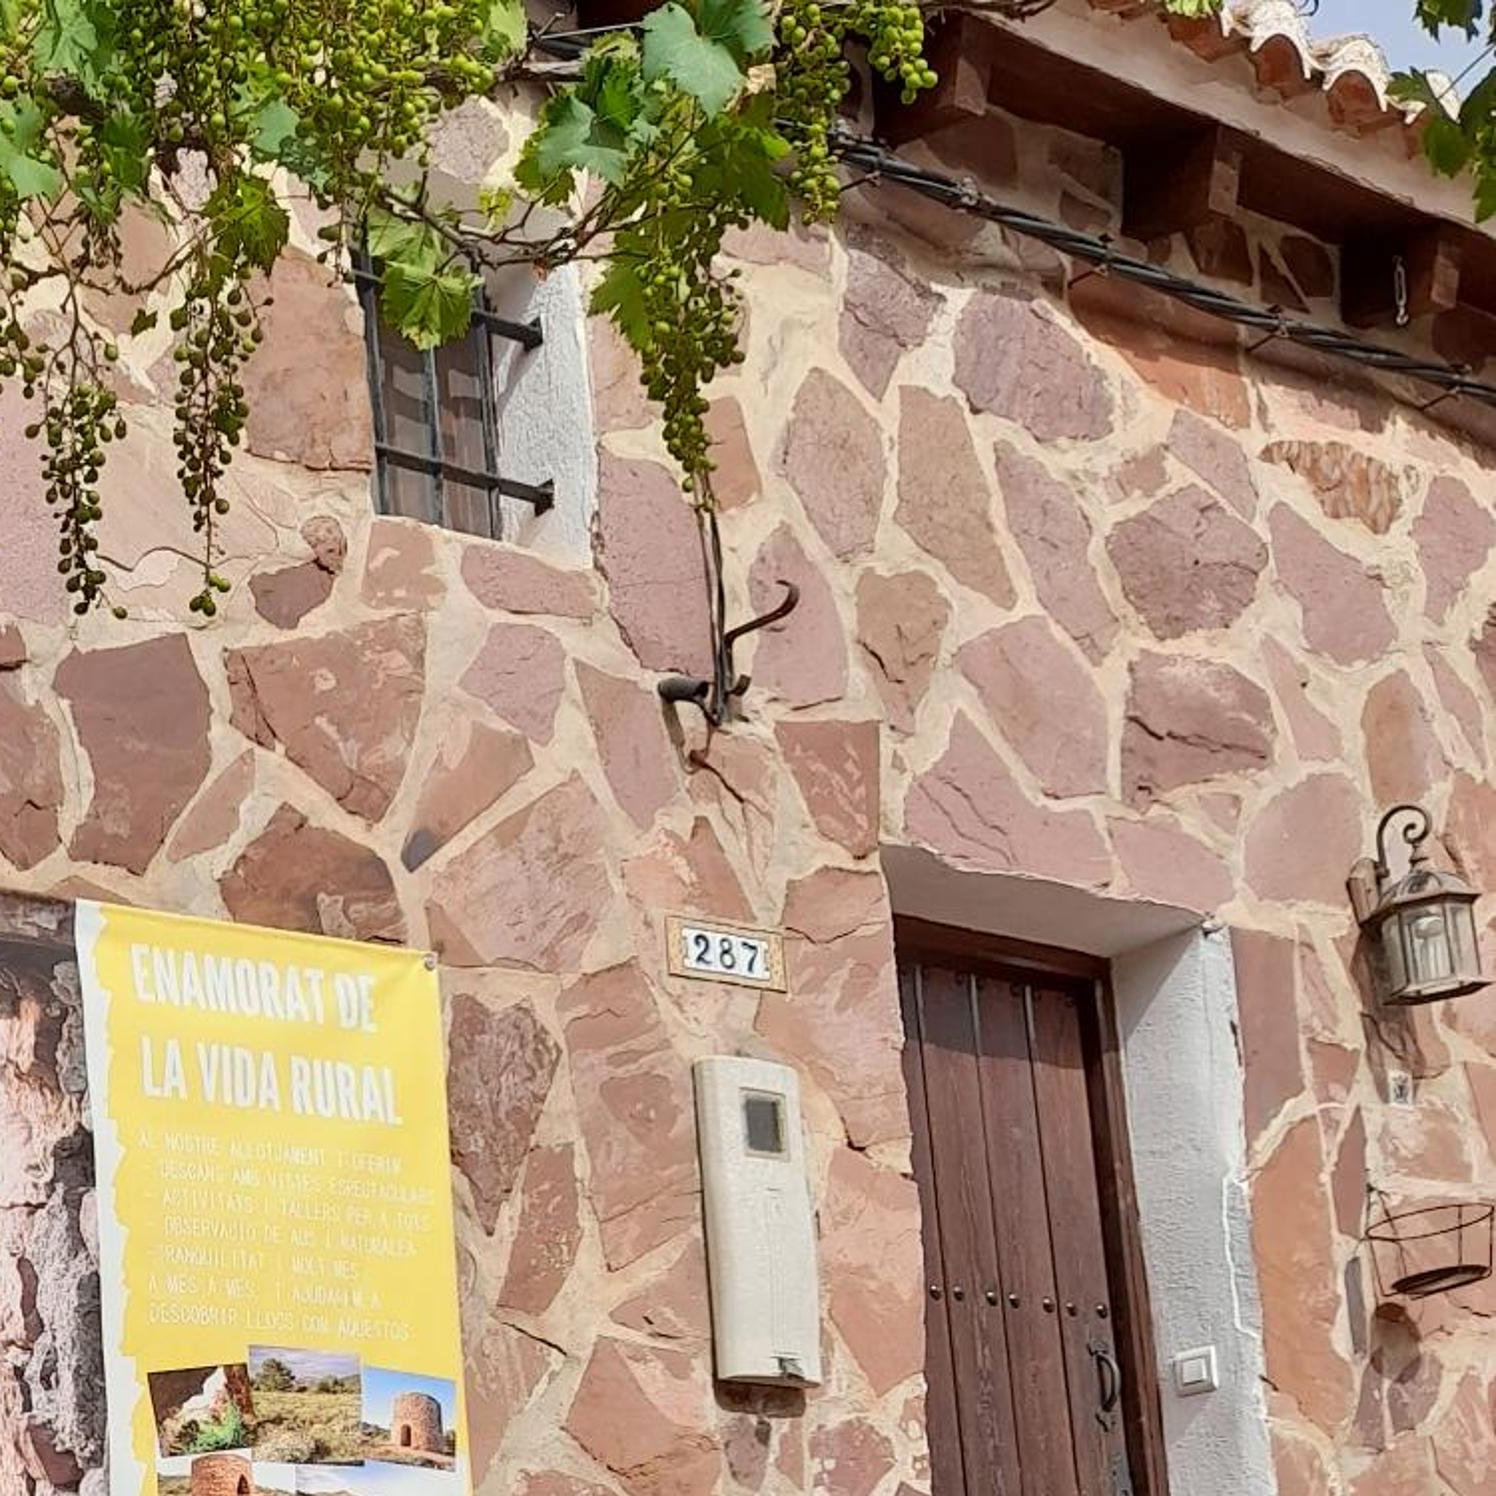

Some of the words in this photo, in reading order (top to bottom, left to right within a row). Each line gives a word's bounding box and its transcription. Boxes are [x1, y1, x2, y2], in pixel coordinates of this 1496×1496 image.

[130, 943, 325, 1026] ENAMORAT
[334, 972, 379, 1033] DE
[694, 933, 759, 973] 287
[140, 1034, 189, 1101] LA
[197, 1041, 281, 1112] VIDA
[290, 1055, 404, 1126] RURAL
